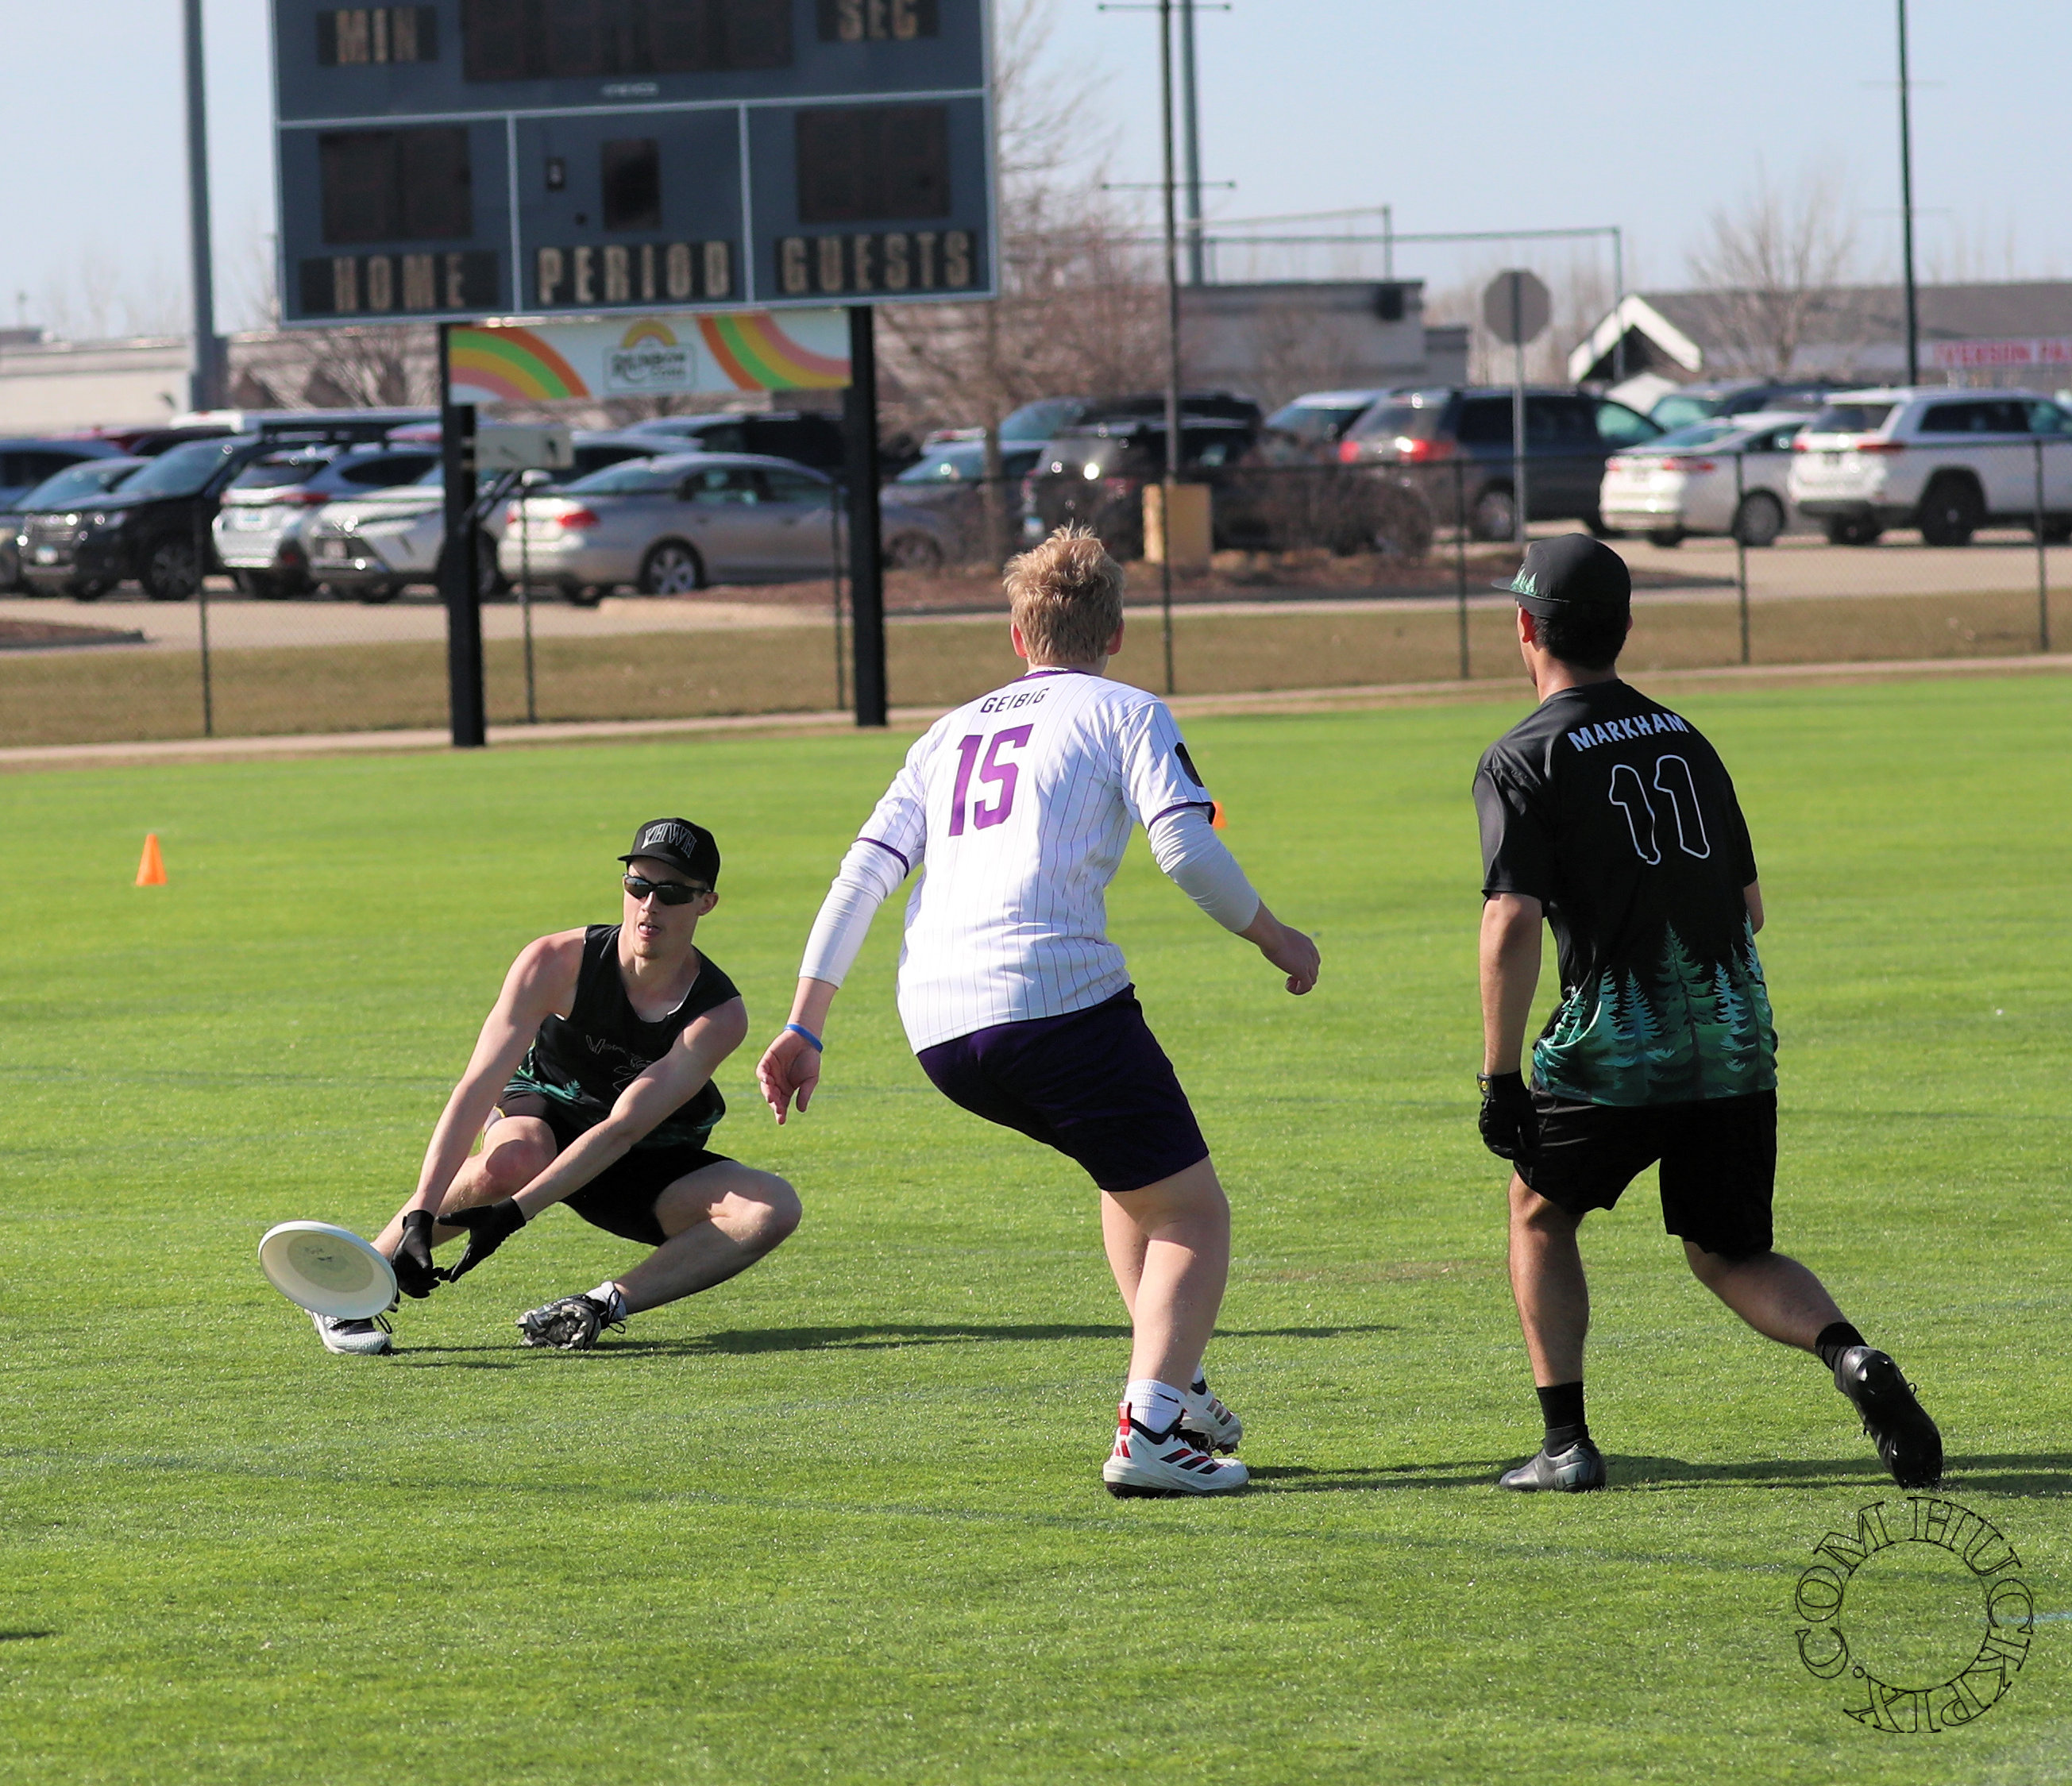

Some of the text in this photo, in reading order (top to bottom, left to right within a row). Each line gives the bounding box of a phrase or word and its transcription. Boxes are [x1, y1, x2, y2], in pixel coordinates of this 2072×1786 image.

[336, 9, 418, 63] MIN
[334, 254, 464, 311] HOME
[538, 241, 730, 304] PERIOD
[781, 230, 970, 294] GUESTS
[980, 687, 1049, 713] GEIBIG
[1567, 712, 1689, 752] MARKHAM
[949, 723, 1035, 837] 15
[1608, 754, 1711, 866] 11
